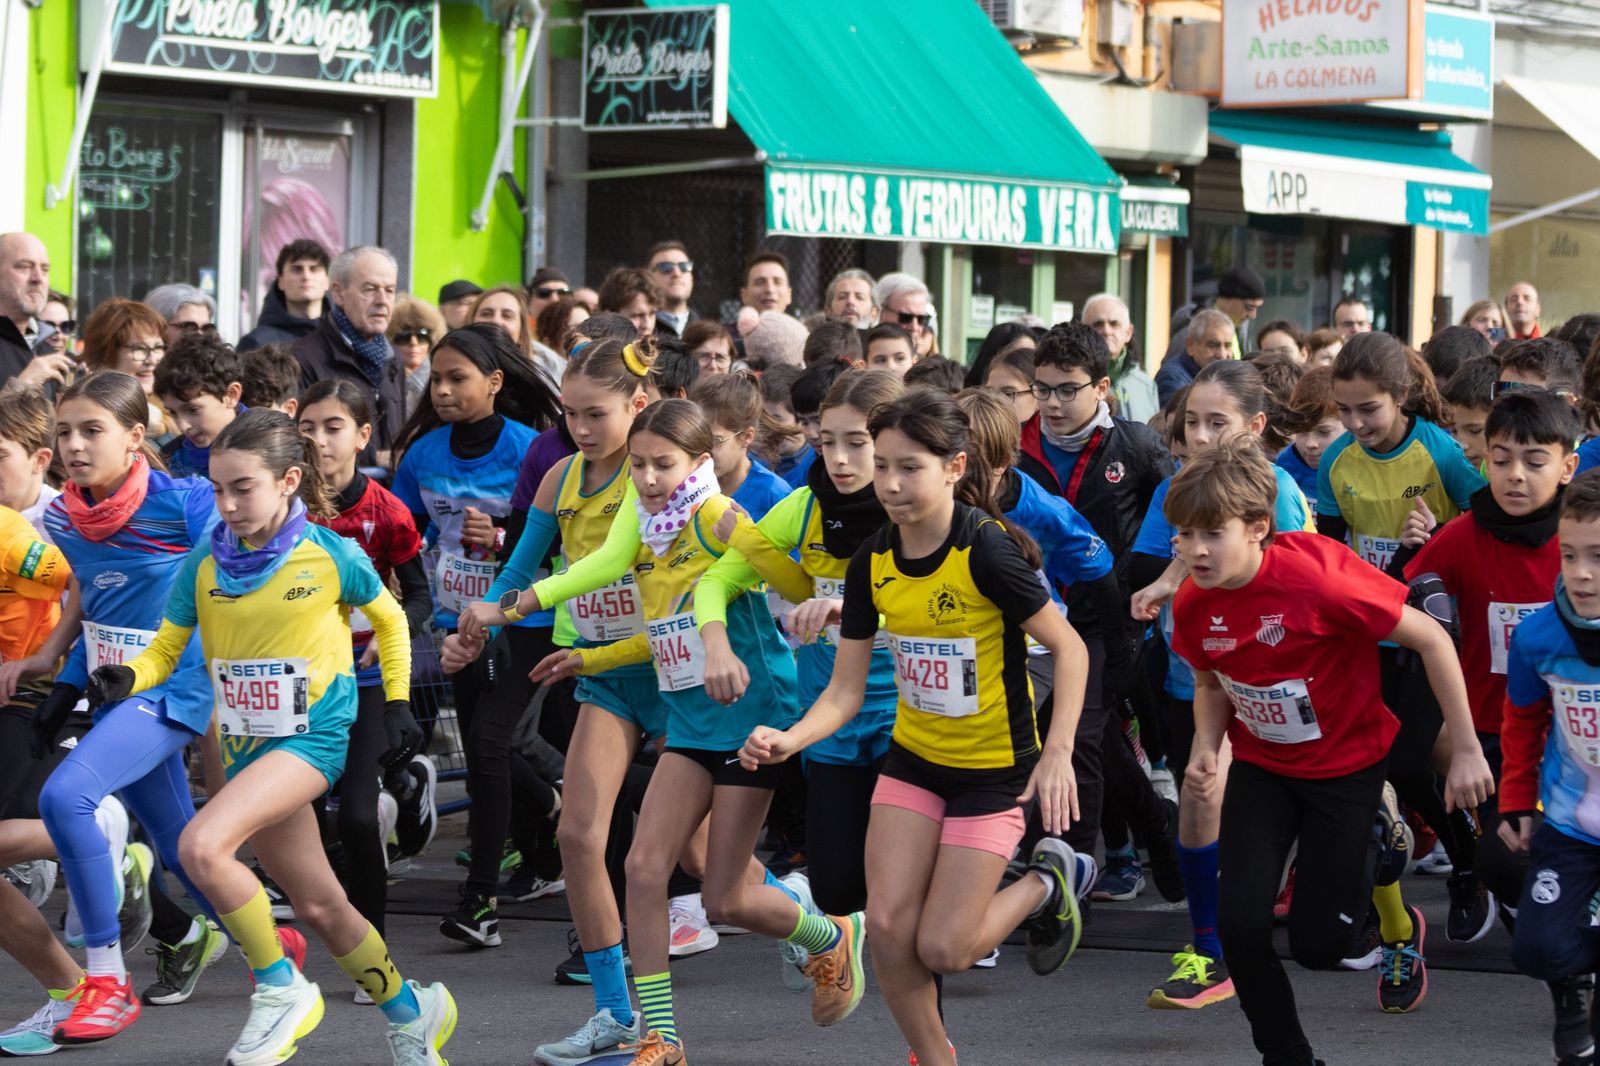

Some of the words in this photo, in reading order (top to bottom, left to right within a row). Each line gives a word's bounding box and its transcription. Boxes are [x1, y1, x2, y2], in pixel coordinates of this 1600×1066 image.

[268, 0, 373, 64] Borges
[591, 42, 643, 75] Prieto
[650, 40, 712, 81] Borges
[1248, 34, 1390, 61] Arte-Sanos
[1255, 71, 1278, 90] LA
[1284, 66, 1377, 88] COLMENA
[769, 171, 867, 234] FRUTAS
[872, 176, 892, 236] &
[900, 178, 1027, 244] VERDURAS
[1038, 187, 1115, 251] VERA
[1121, 201, 1135, 229] LA
[443, 570, 489, 599] 6400
[577, 588, 636, 619] 6456
[98, 629, 147, 647] SETEL
[649, 616, 698, 637] SETEL
[900, 641, 964, 656] SETEL
[231, 663, 288, 677] SETE
[896, 653, 949, 691] 6428
[224, 680, 279, 710] 6496
[1232, 684, 1296, 700] SETEL
